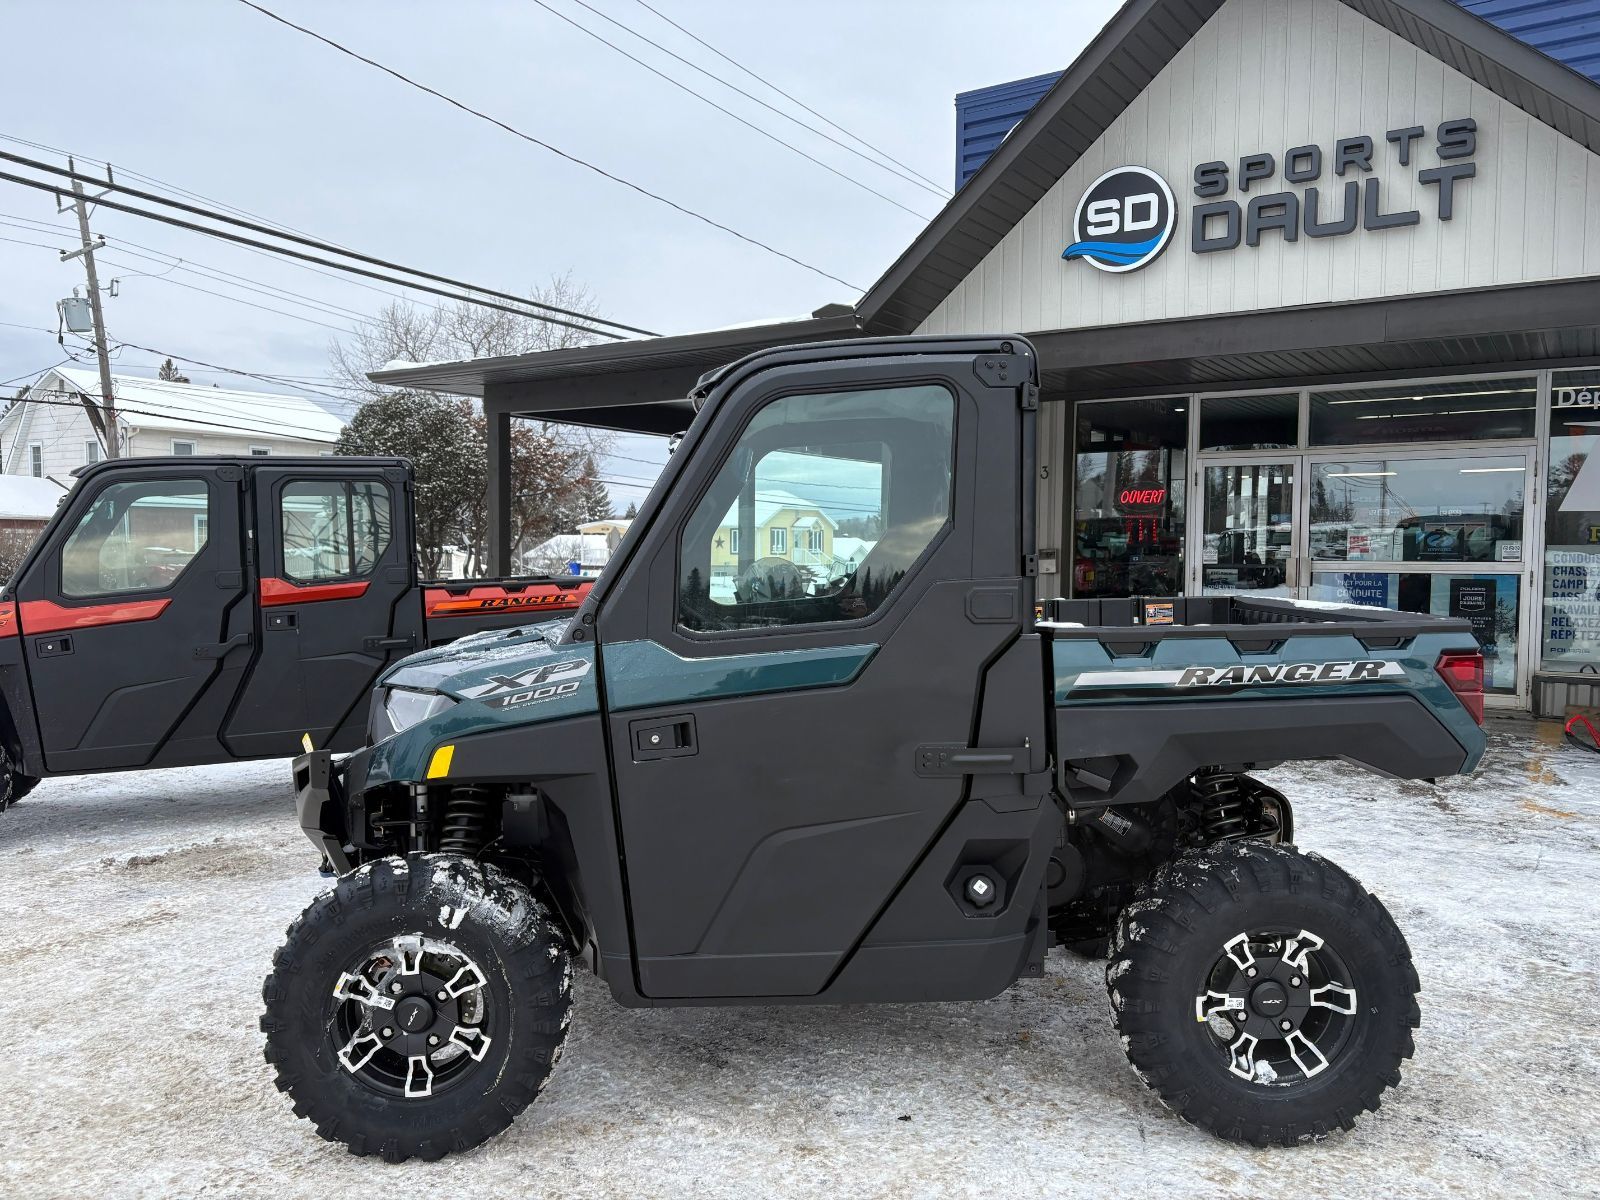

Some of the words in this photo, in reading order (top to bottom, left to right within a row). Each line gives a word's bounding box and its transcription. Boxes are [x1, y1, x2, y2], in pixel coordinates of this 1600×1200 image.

[1193, 117, 1477, 198] SPORTS
[1086, 192, 1159, 237] SD
[1192, 162, 1476, 254] DAULT
[1040, 465, 1048, 479] 3
[1120, 489, 1166, 504] OUVERT
[480, 594, 569, 608] RANGER
[1337, 589, 1382, 598] CONDUITE
[476, 658, 589, 697] XP
[1175, 659, 1386, 687] RANGER
[502, 681, 581, 706] 1000
